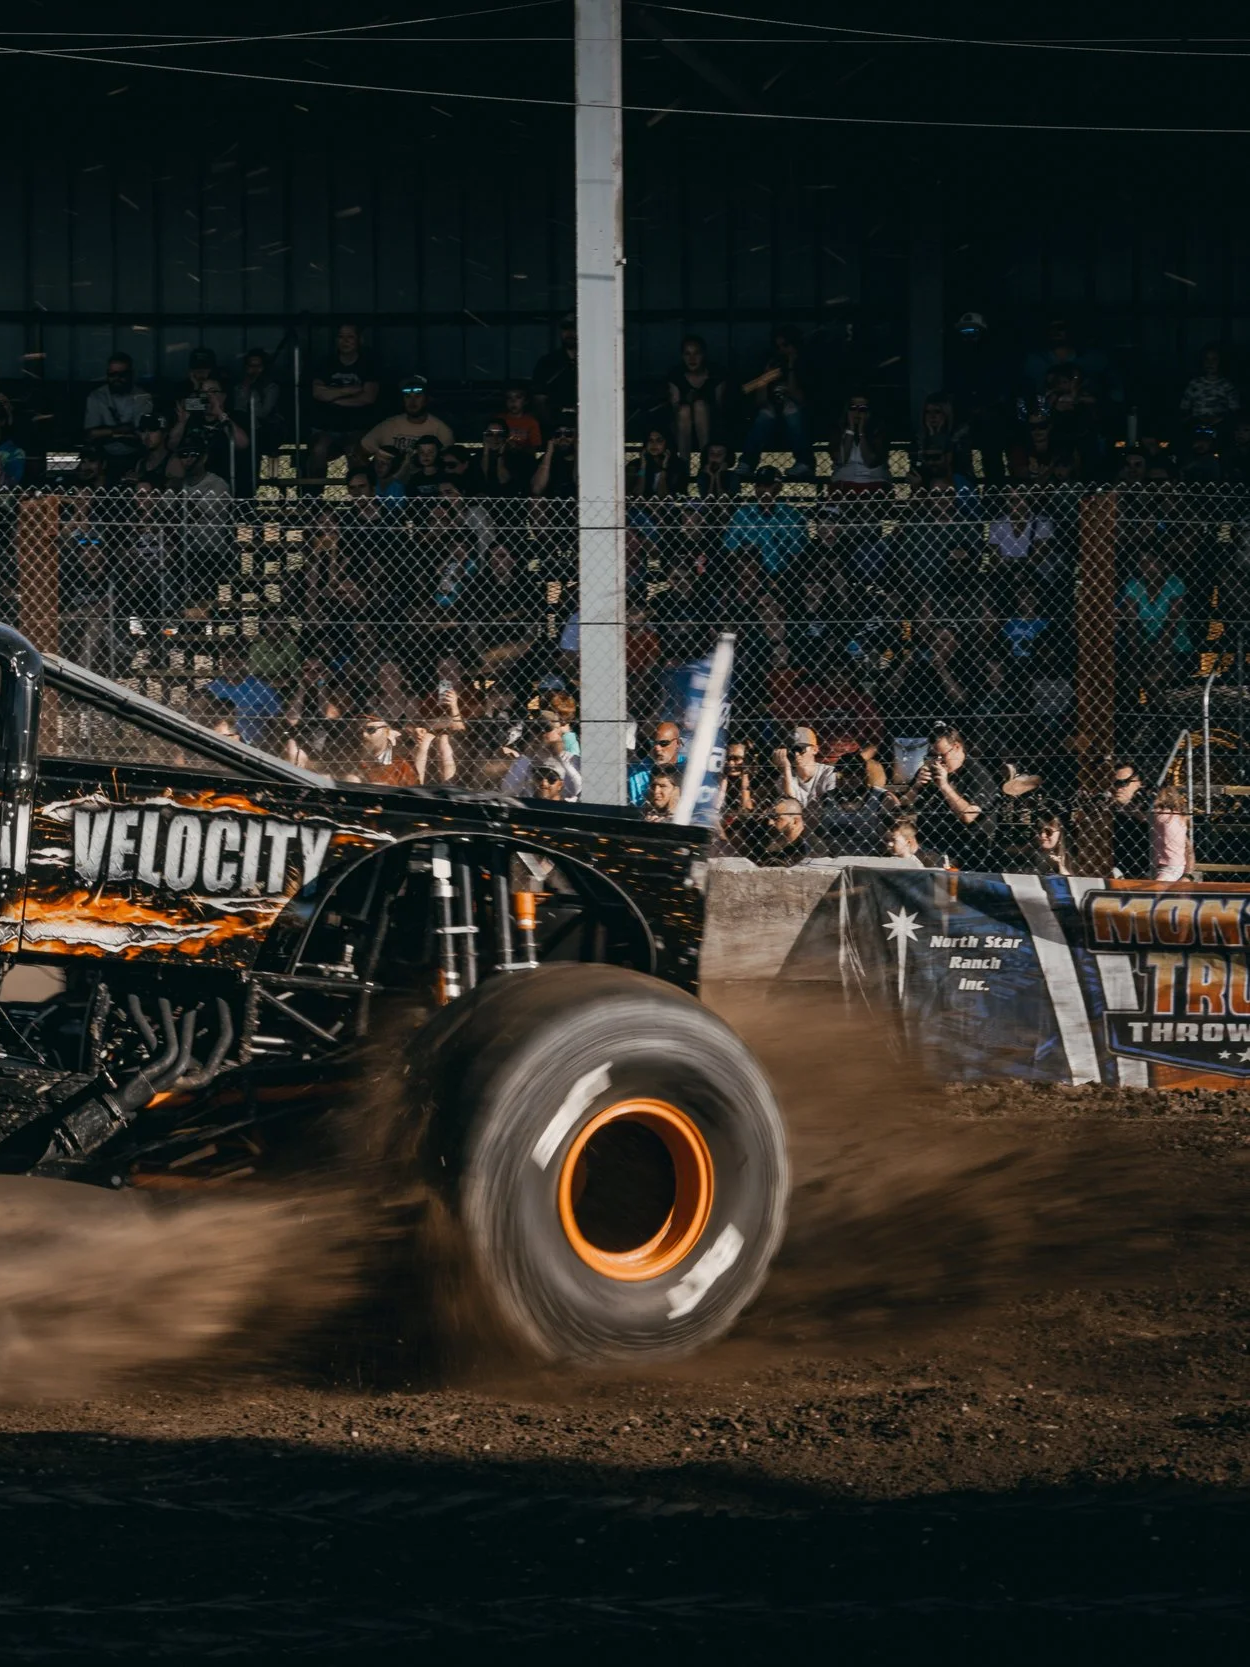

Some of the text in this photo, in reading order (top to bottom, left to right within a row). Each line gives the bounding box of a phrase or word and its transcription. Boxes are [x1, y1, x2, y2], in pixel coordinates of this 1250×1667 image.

[73, 807, 333, 897] VELOCITY
[1091, 896, 1250, 947] MON
[930, 935, 1023, 948] North Star
[949, 956, 1002, 969] Ranch
[958, 978, 990, 991] Inc.
